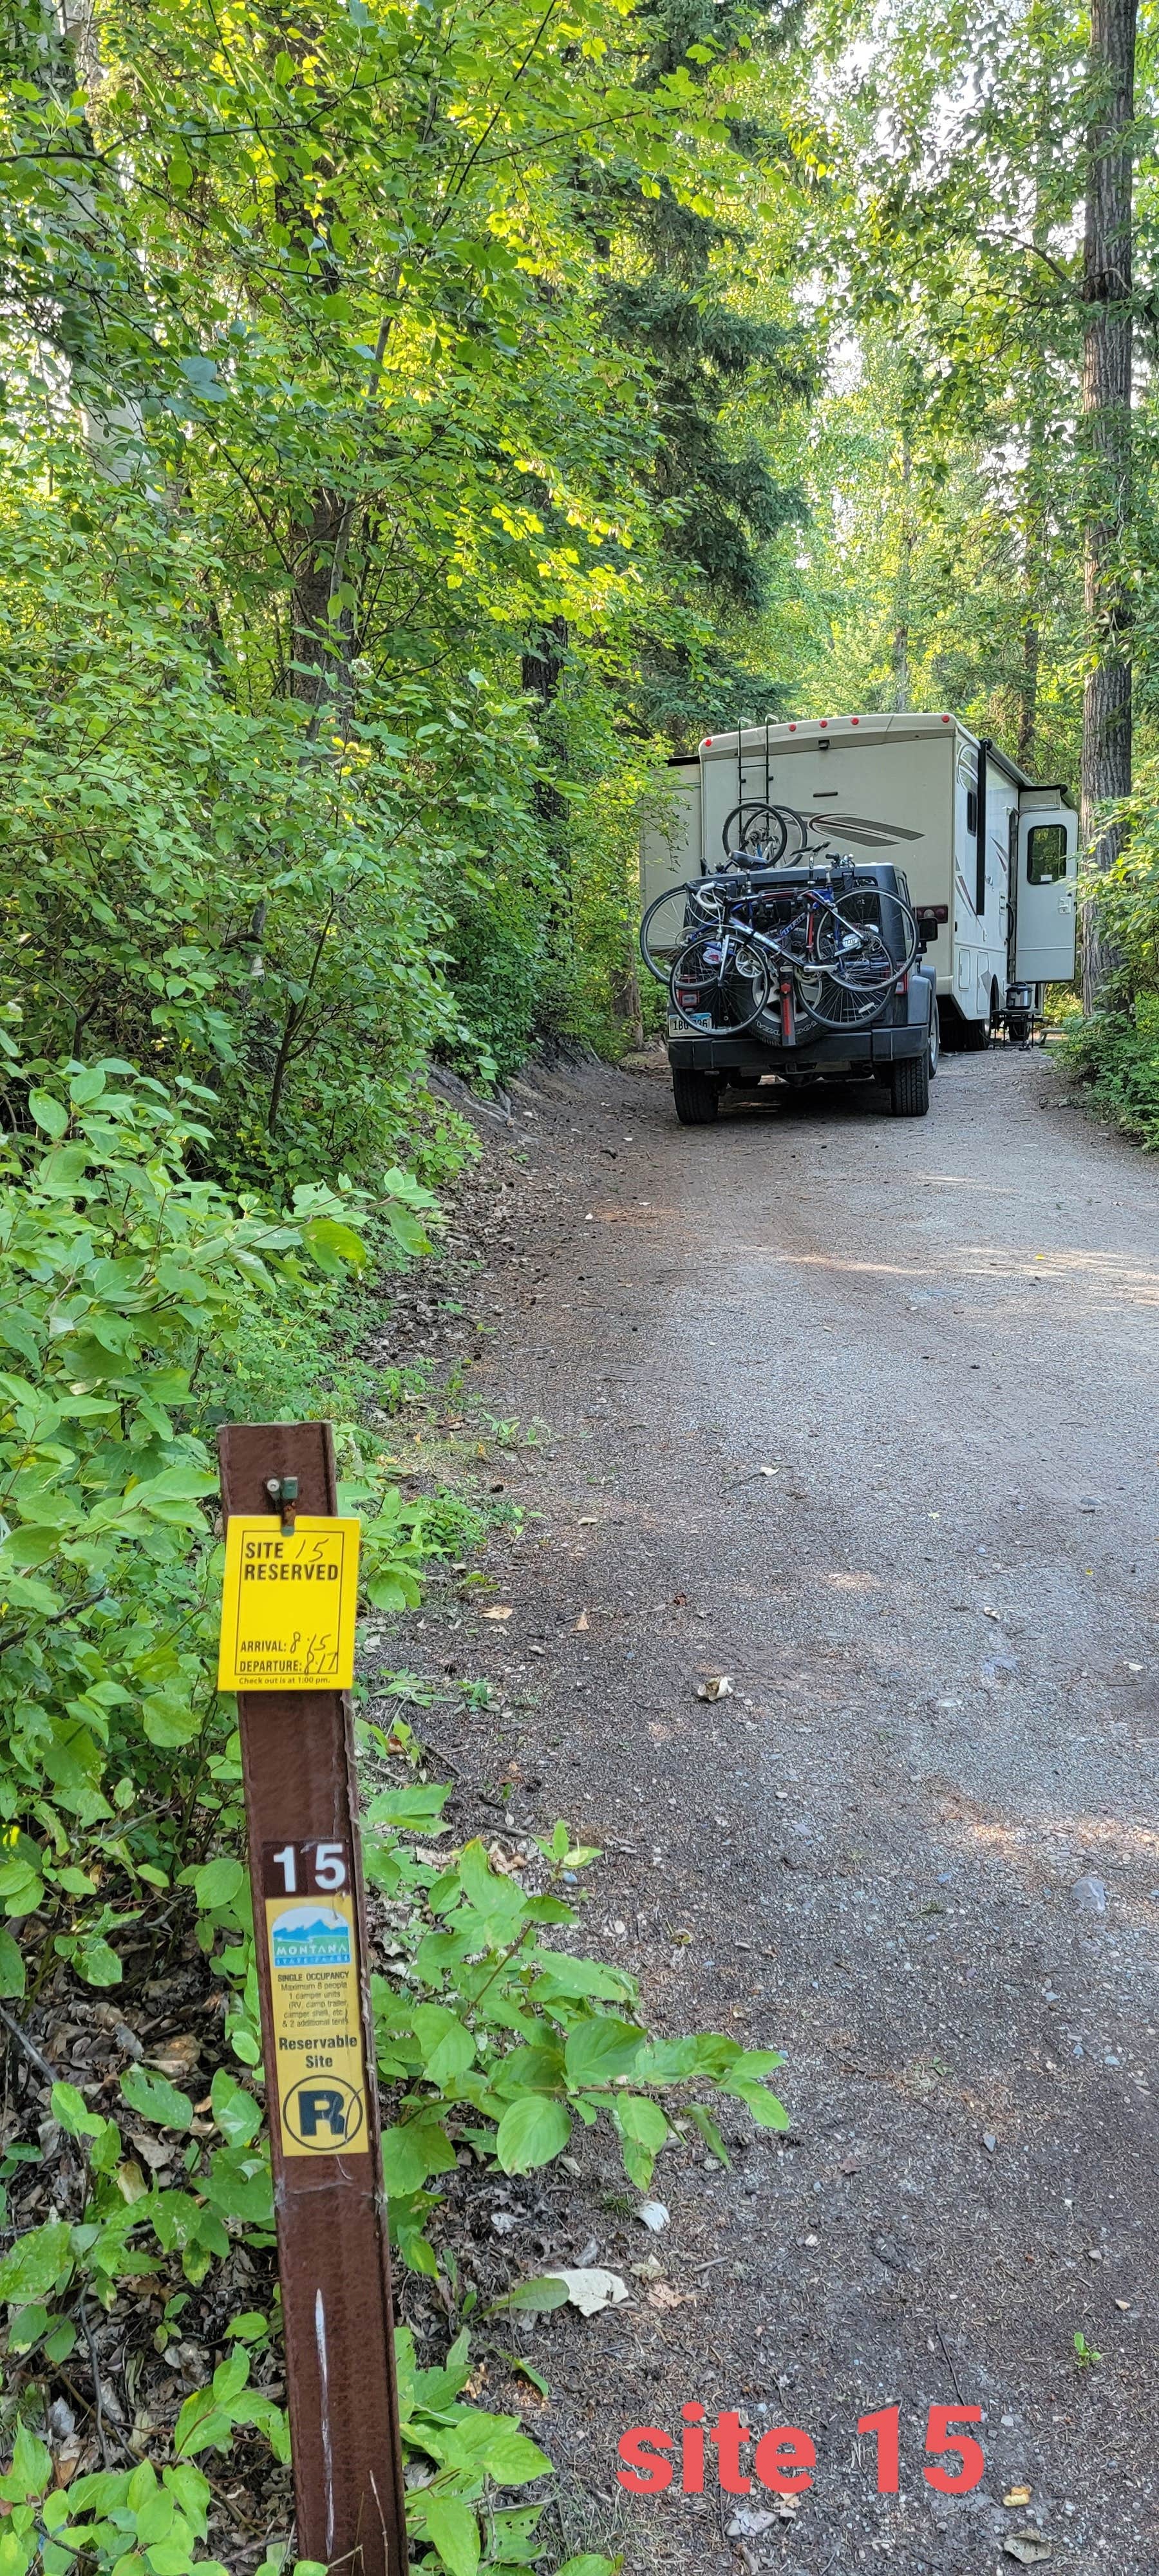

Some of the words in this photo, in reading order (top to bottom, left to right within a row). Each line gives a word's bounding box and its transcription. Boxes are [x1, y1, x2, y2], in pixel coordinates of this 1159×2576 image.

[245, 1542, 284, 1558] SITE
[295, 1538, 330, 1563] 15
[244, 1564, 339, 1580] RESERVED
[240, 1640, 287, 1653] ARRIVAL:
[240, 1660, 303, 1672] DEPARTURE:
[273, 1844, 346, 1893] 15
[276, 1944, 347, 1956] MONTANA
[278, 1973, 303, 1982] SINGLE
[306, 1971, 350, 1981] OCCUPANCY
[281, 1983, 316, 1991] Maximum
[324, 1981, 348, 1990] people
[290, 2020, 294, 2028] 2
[297, 2019, 330, 2027] additional
[279, 2035, 357, 2050] Reservable
[305, 2055, 333, 2069] Site
[297, 2089, 345, 2137] R
